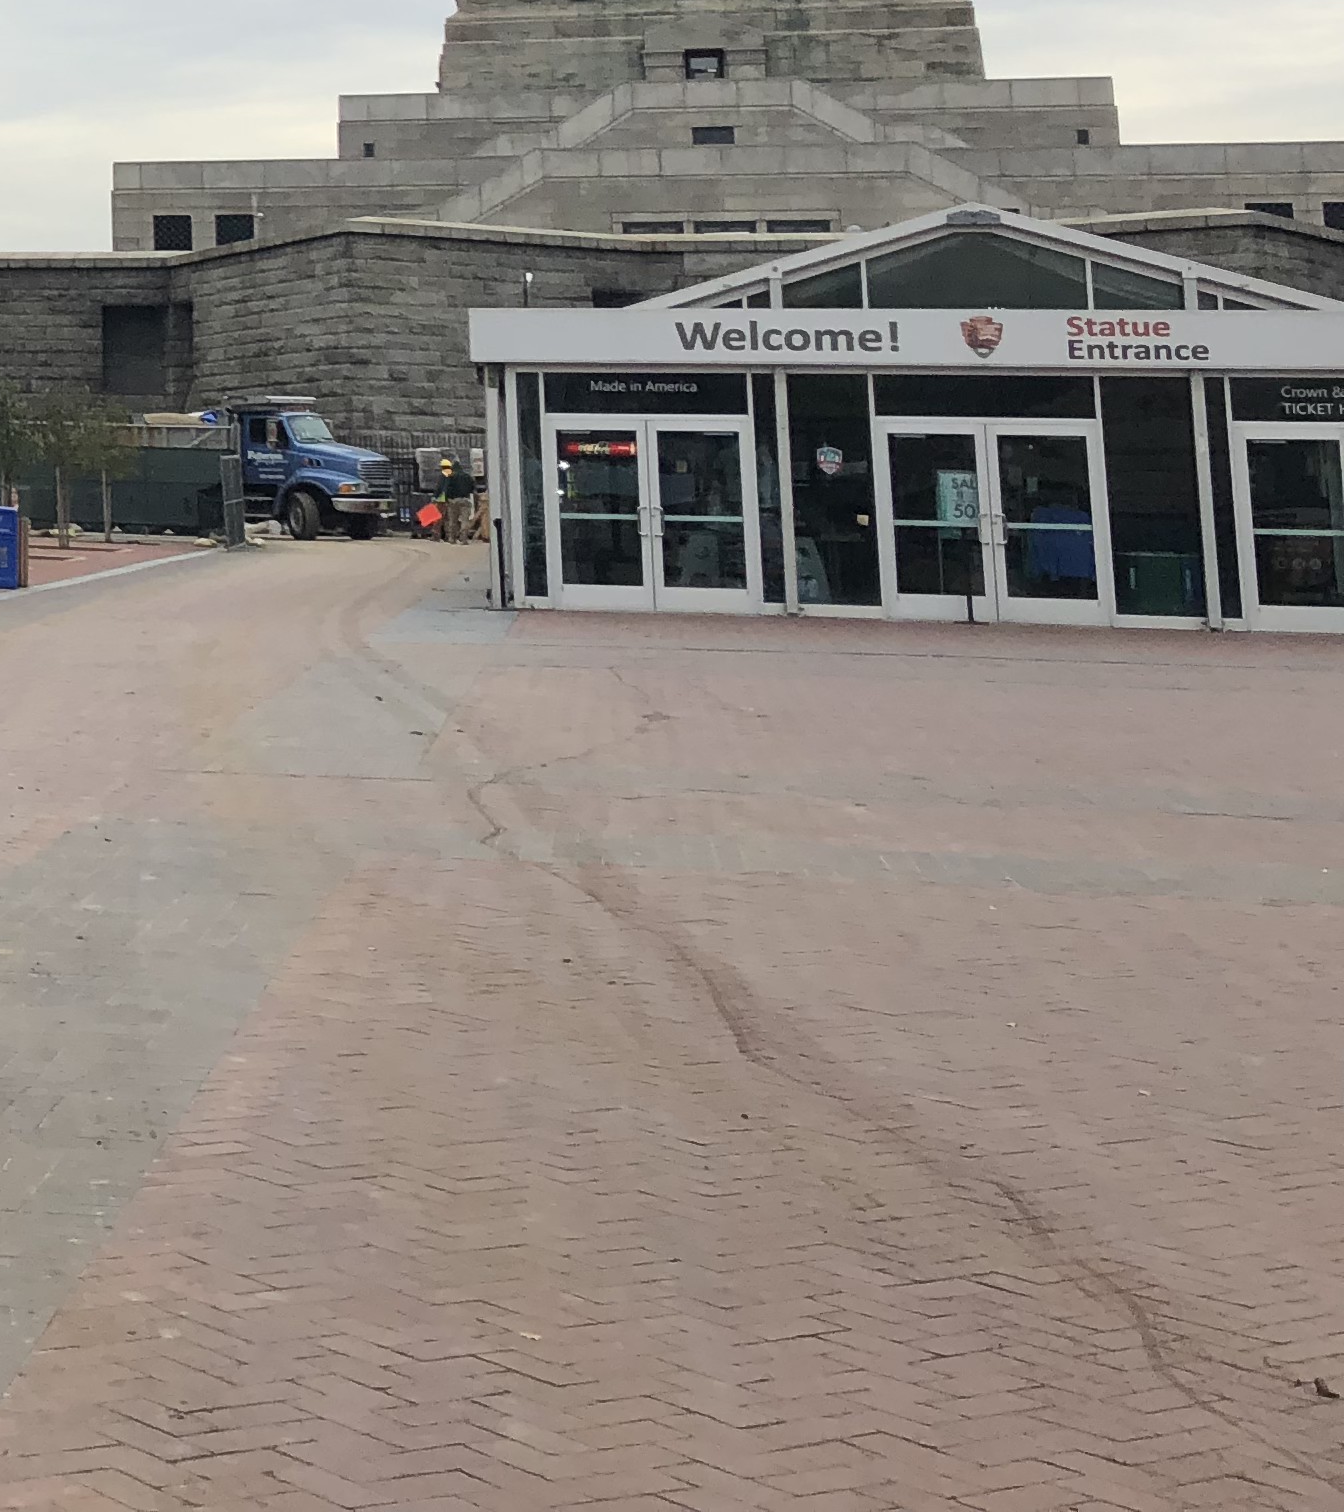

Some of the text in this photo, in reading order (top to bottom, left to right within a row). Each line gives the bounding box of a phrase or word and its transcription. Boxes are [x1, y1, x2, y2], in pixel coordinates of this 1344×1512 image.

[1066, 316, 1171, 337] Statue
[675, 320, 900, 352] Welcome!
[1067, 339, 1210, 360] Entrance
[590, 380, 698, 393] Made in America
[1281, 386, 1328, 398] Crown
[1281, 402, 1334, 415] TICKET
